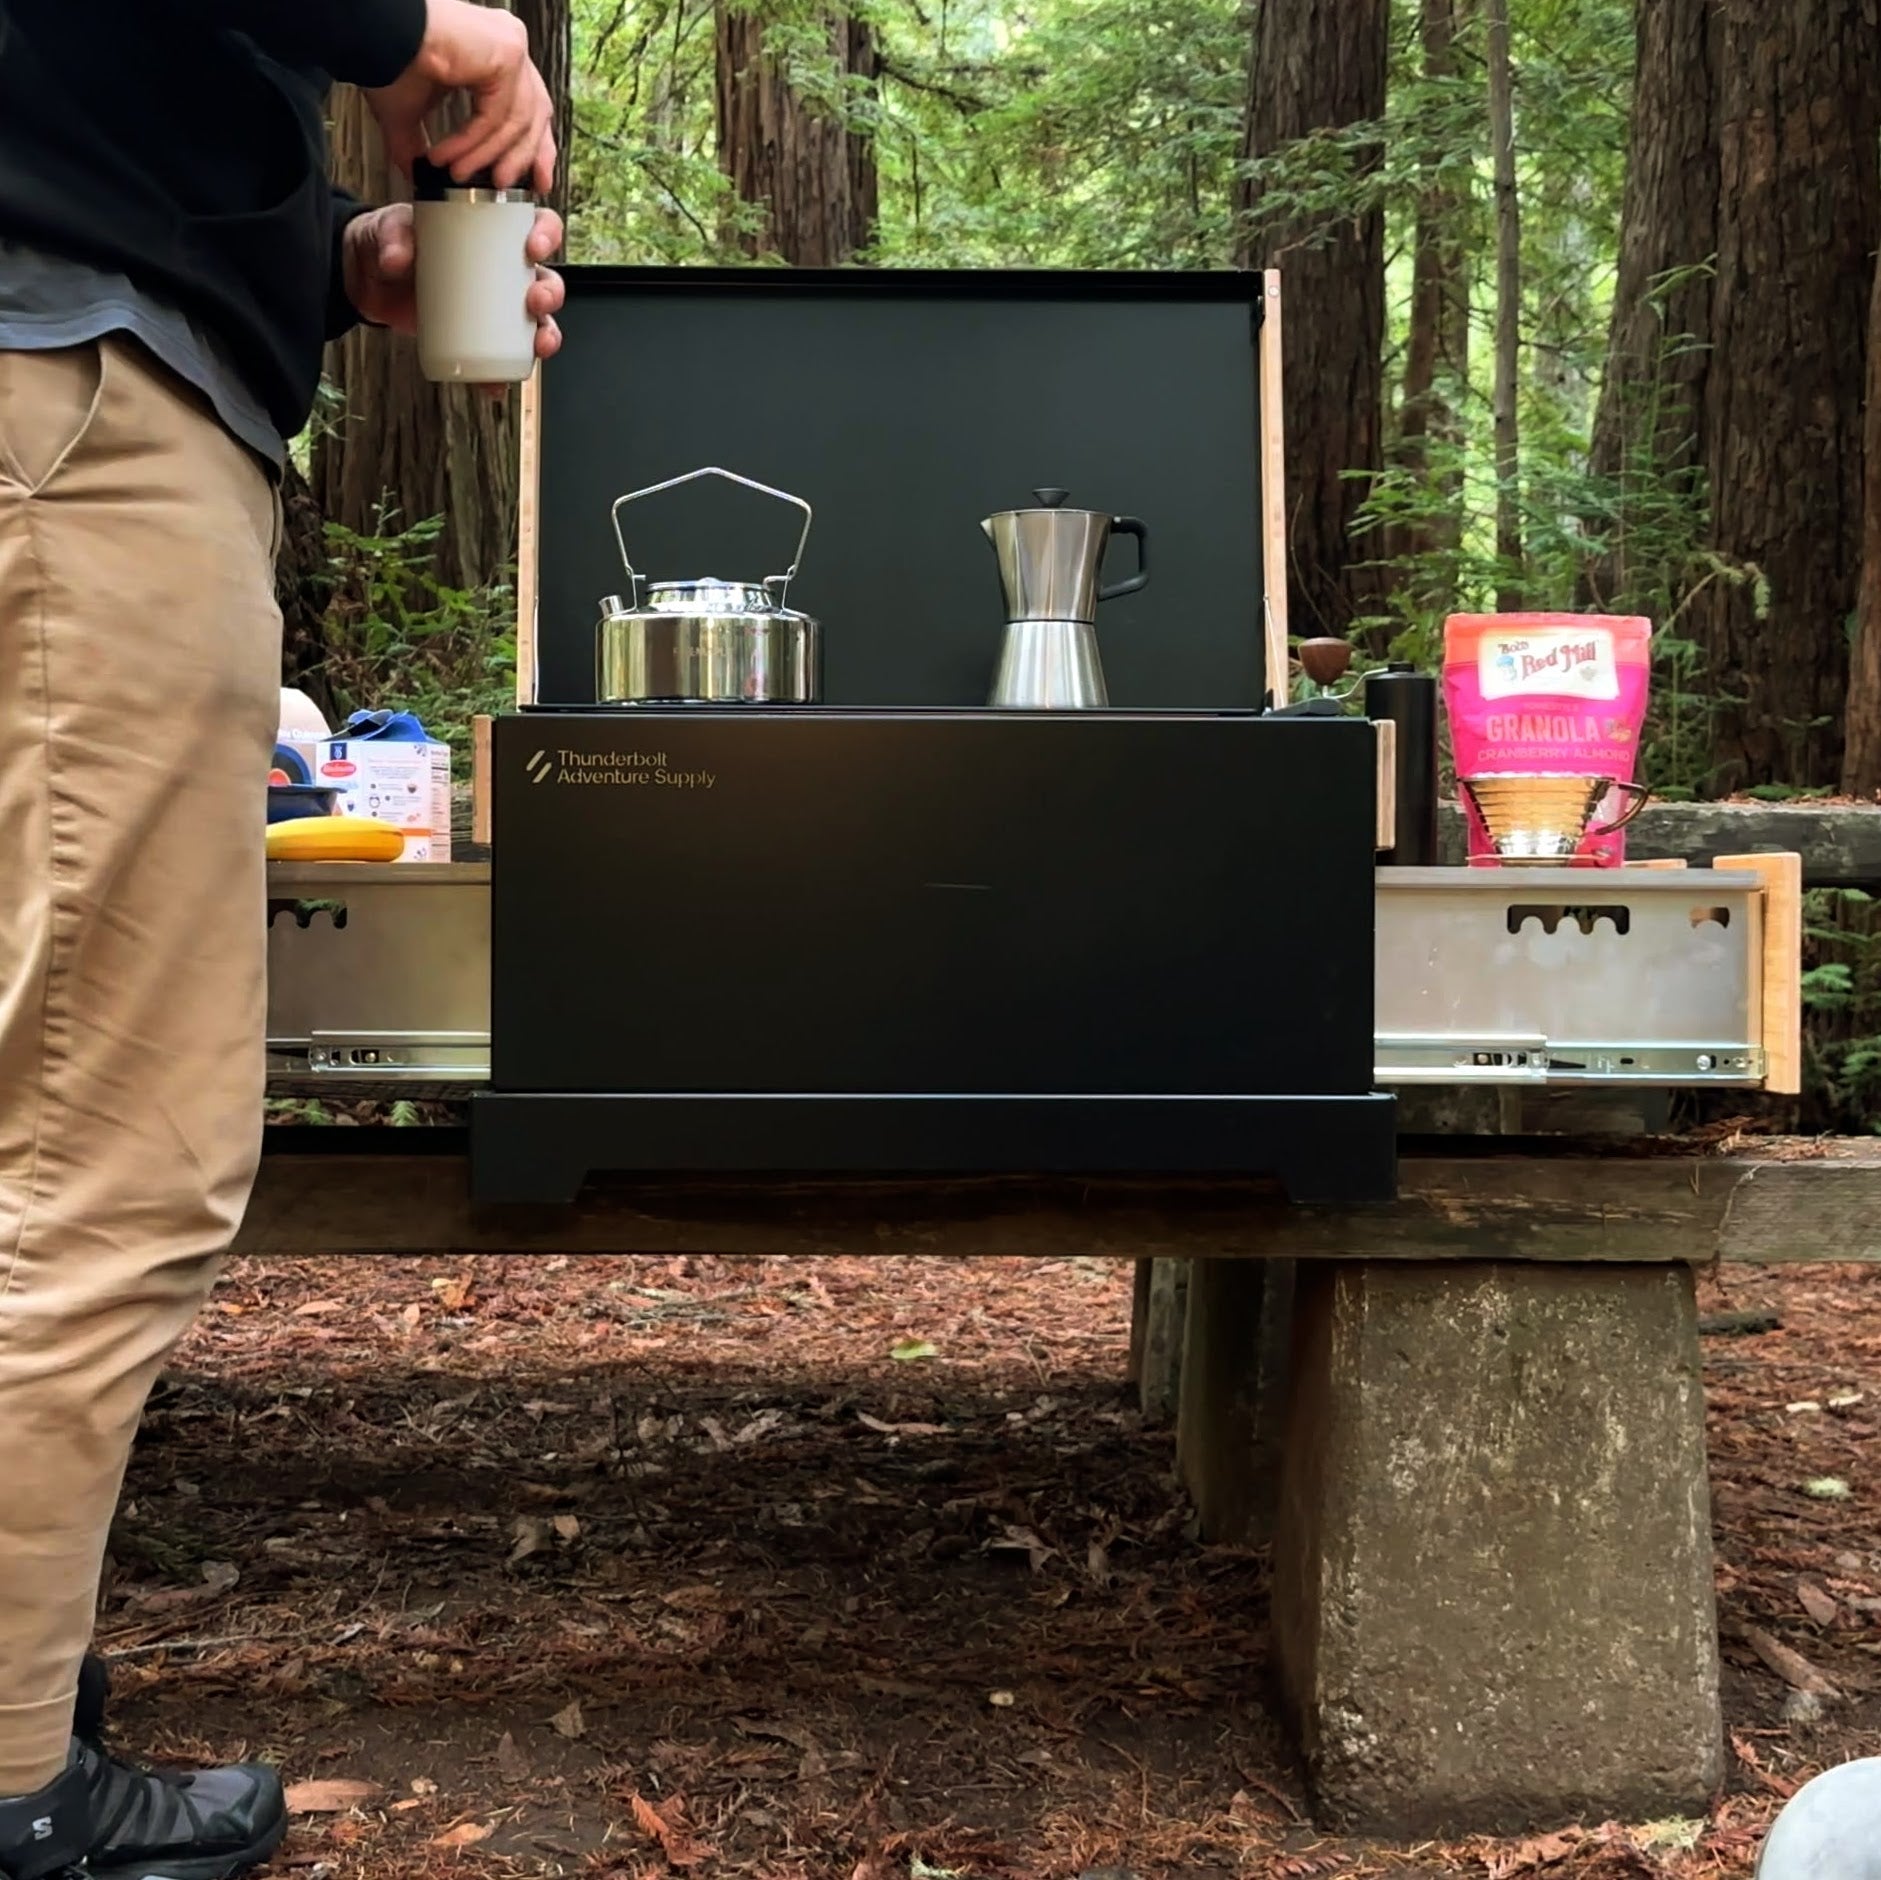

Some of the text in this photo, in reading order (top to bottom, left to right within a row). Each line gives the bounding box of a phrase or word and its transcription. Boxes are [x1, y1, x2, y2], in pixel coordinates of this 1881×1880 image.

[1521, 641, 1597, 680] Red Mill
[1486, 714, 1600, 742] GRANOLA
[557, 750, 667, 767] Thunderbolt
[1477, 747, 1630, 762] CRANBERRY ALMOND
[557, 768, 717, 788] Adventure Supply
